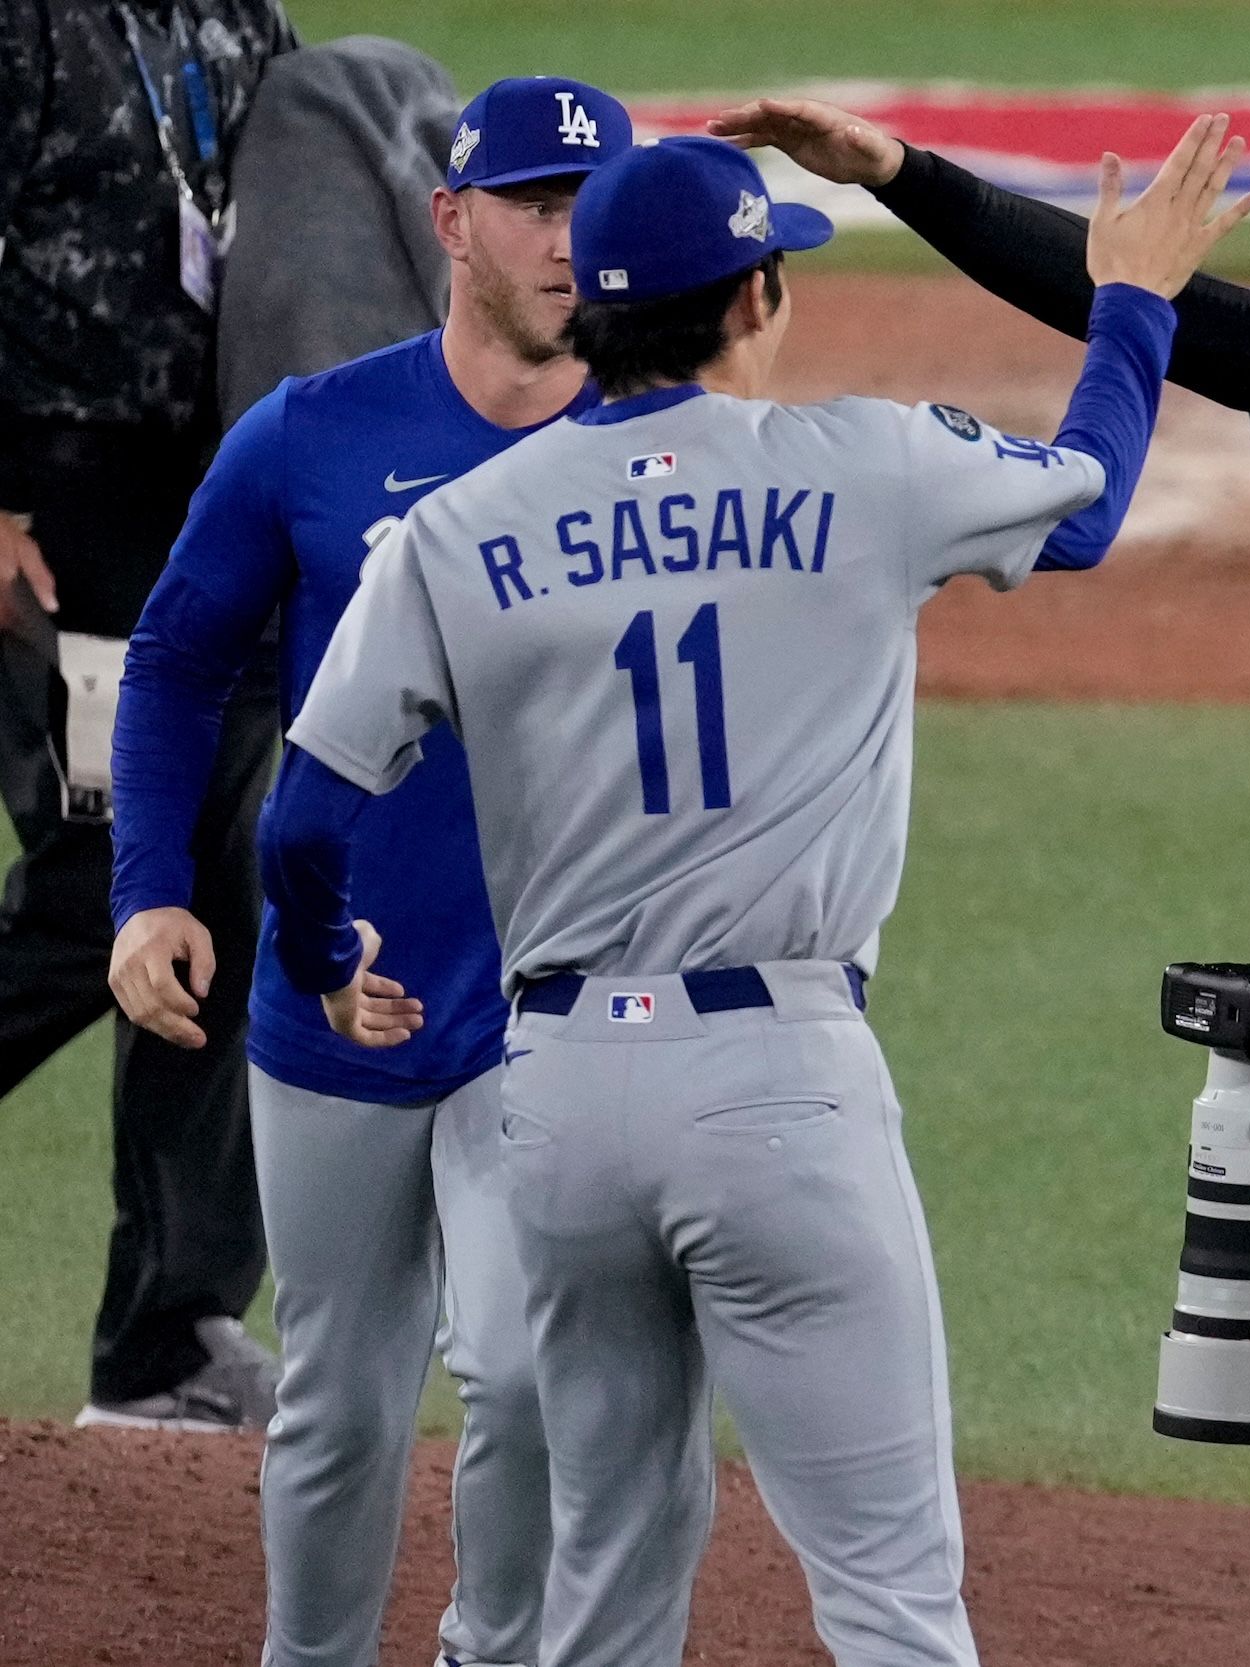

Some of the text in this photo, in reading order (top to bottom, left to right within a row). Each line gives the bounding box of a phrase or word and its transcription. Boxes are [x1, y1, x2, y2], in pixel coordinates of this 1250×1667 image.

[555, 92, 600, 148] LA
[478, 535, 549, 610] R.
[556, 488, 835, 588] SASAKI
[613, 602, 732, 815] 11
